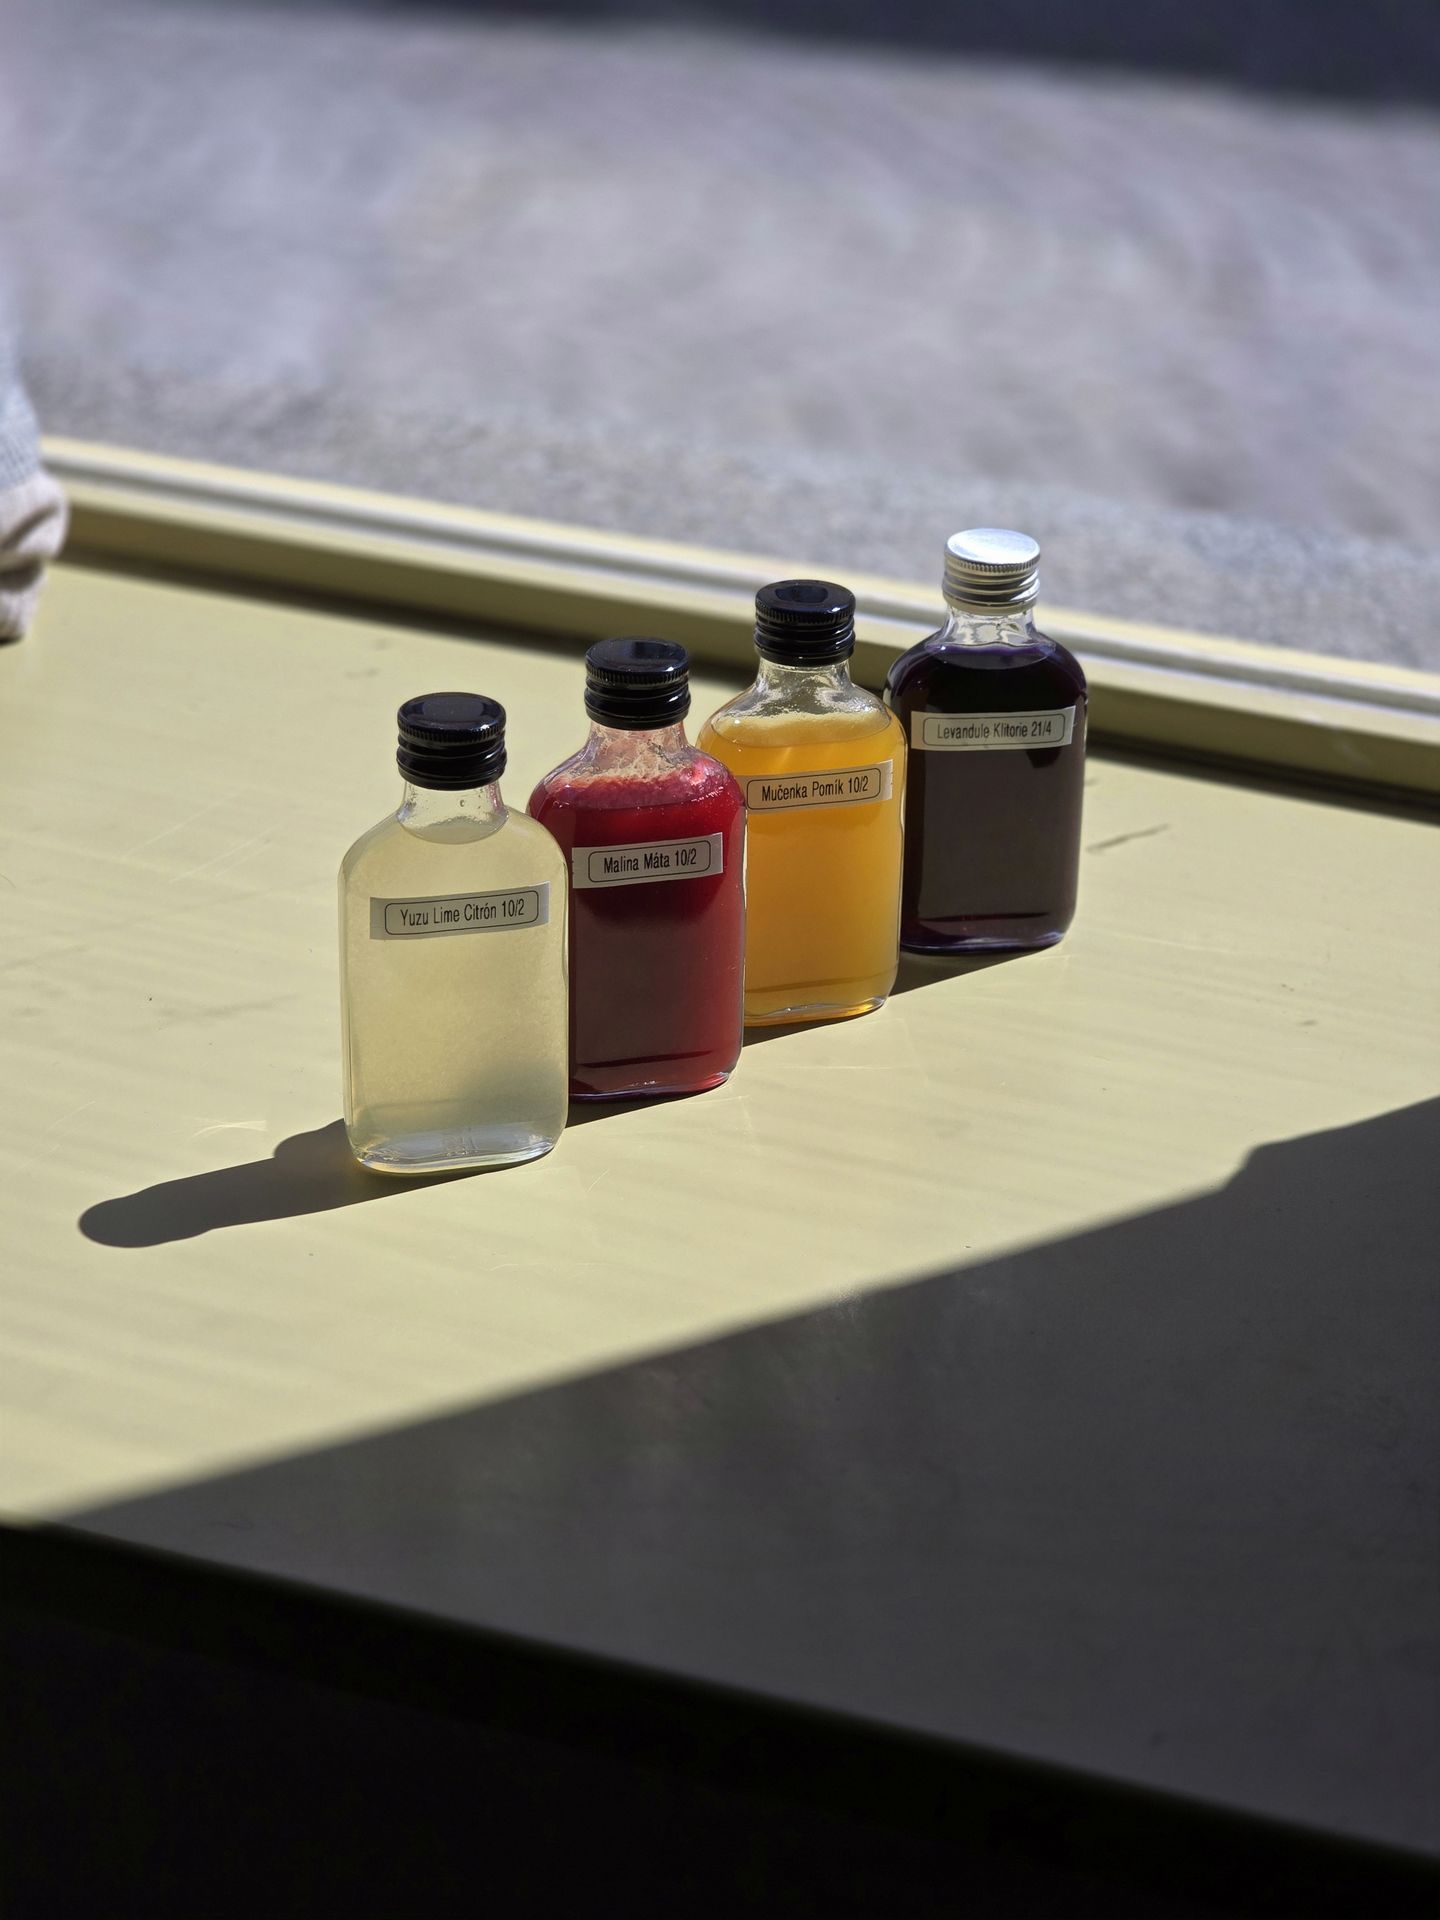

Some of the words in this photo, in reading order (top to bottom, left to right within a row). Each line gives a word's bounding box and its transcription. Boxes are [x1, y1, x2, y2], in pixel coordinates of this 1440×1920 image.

[937, 723, 989, 739] Levandule
[993, 722, 1028, 738] Klitorie
[1031, 720, 1052, 737] 21/4
[762, 783, 808, 802] Mučenka
[848, 775, 869, 794] 10/2
[603, 855, 639, 874] Malina
[643, 852, 670, 870] Máta
[675, 848, 697, 867] 10/2
[400, 909, 429, 926] Yuzu
[433, 907, 460, 924] Lime
[464, 903, 497, 921] Citrón
[501, 898, 525, 917] 10/2
